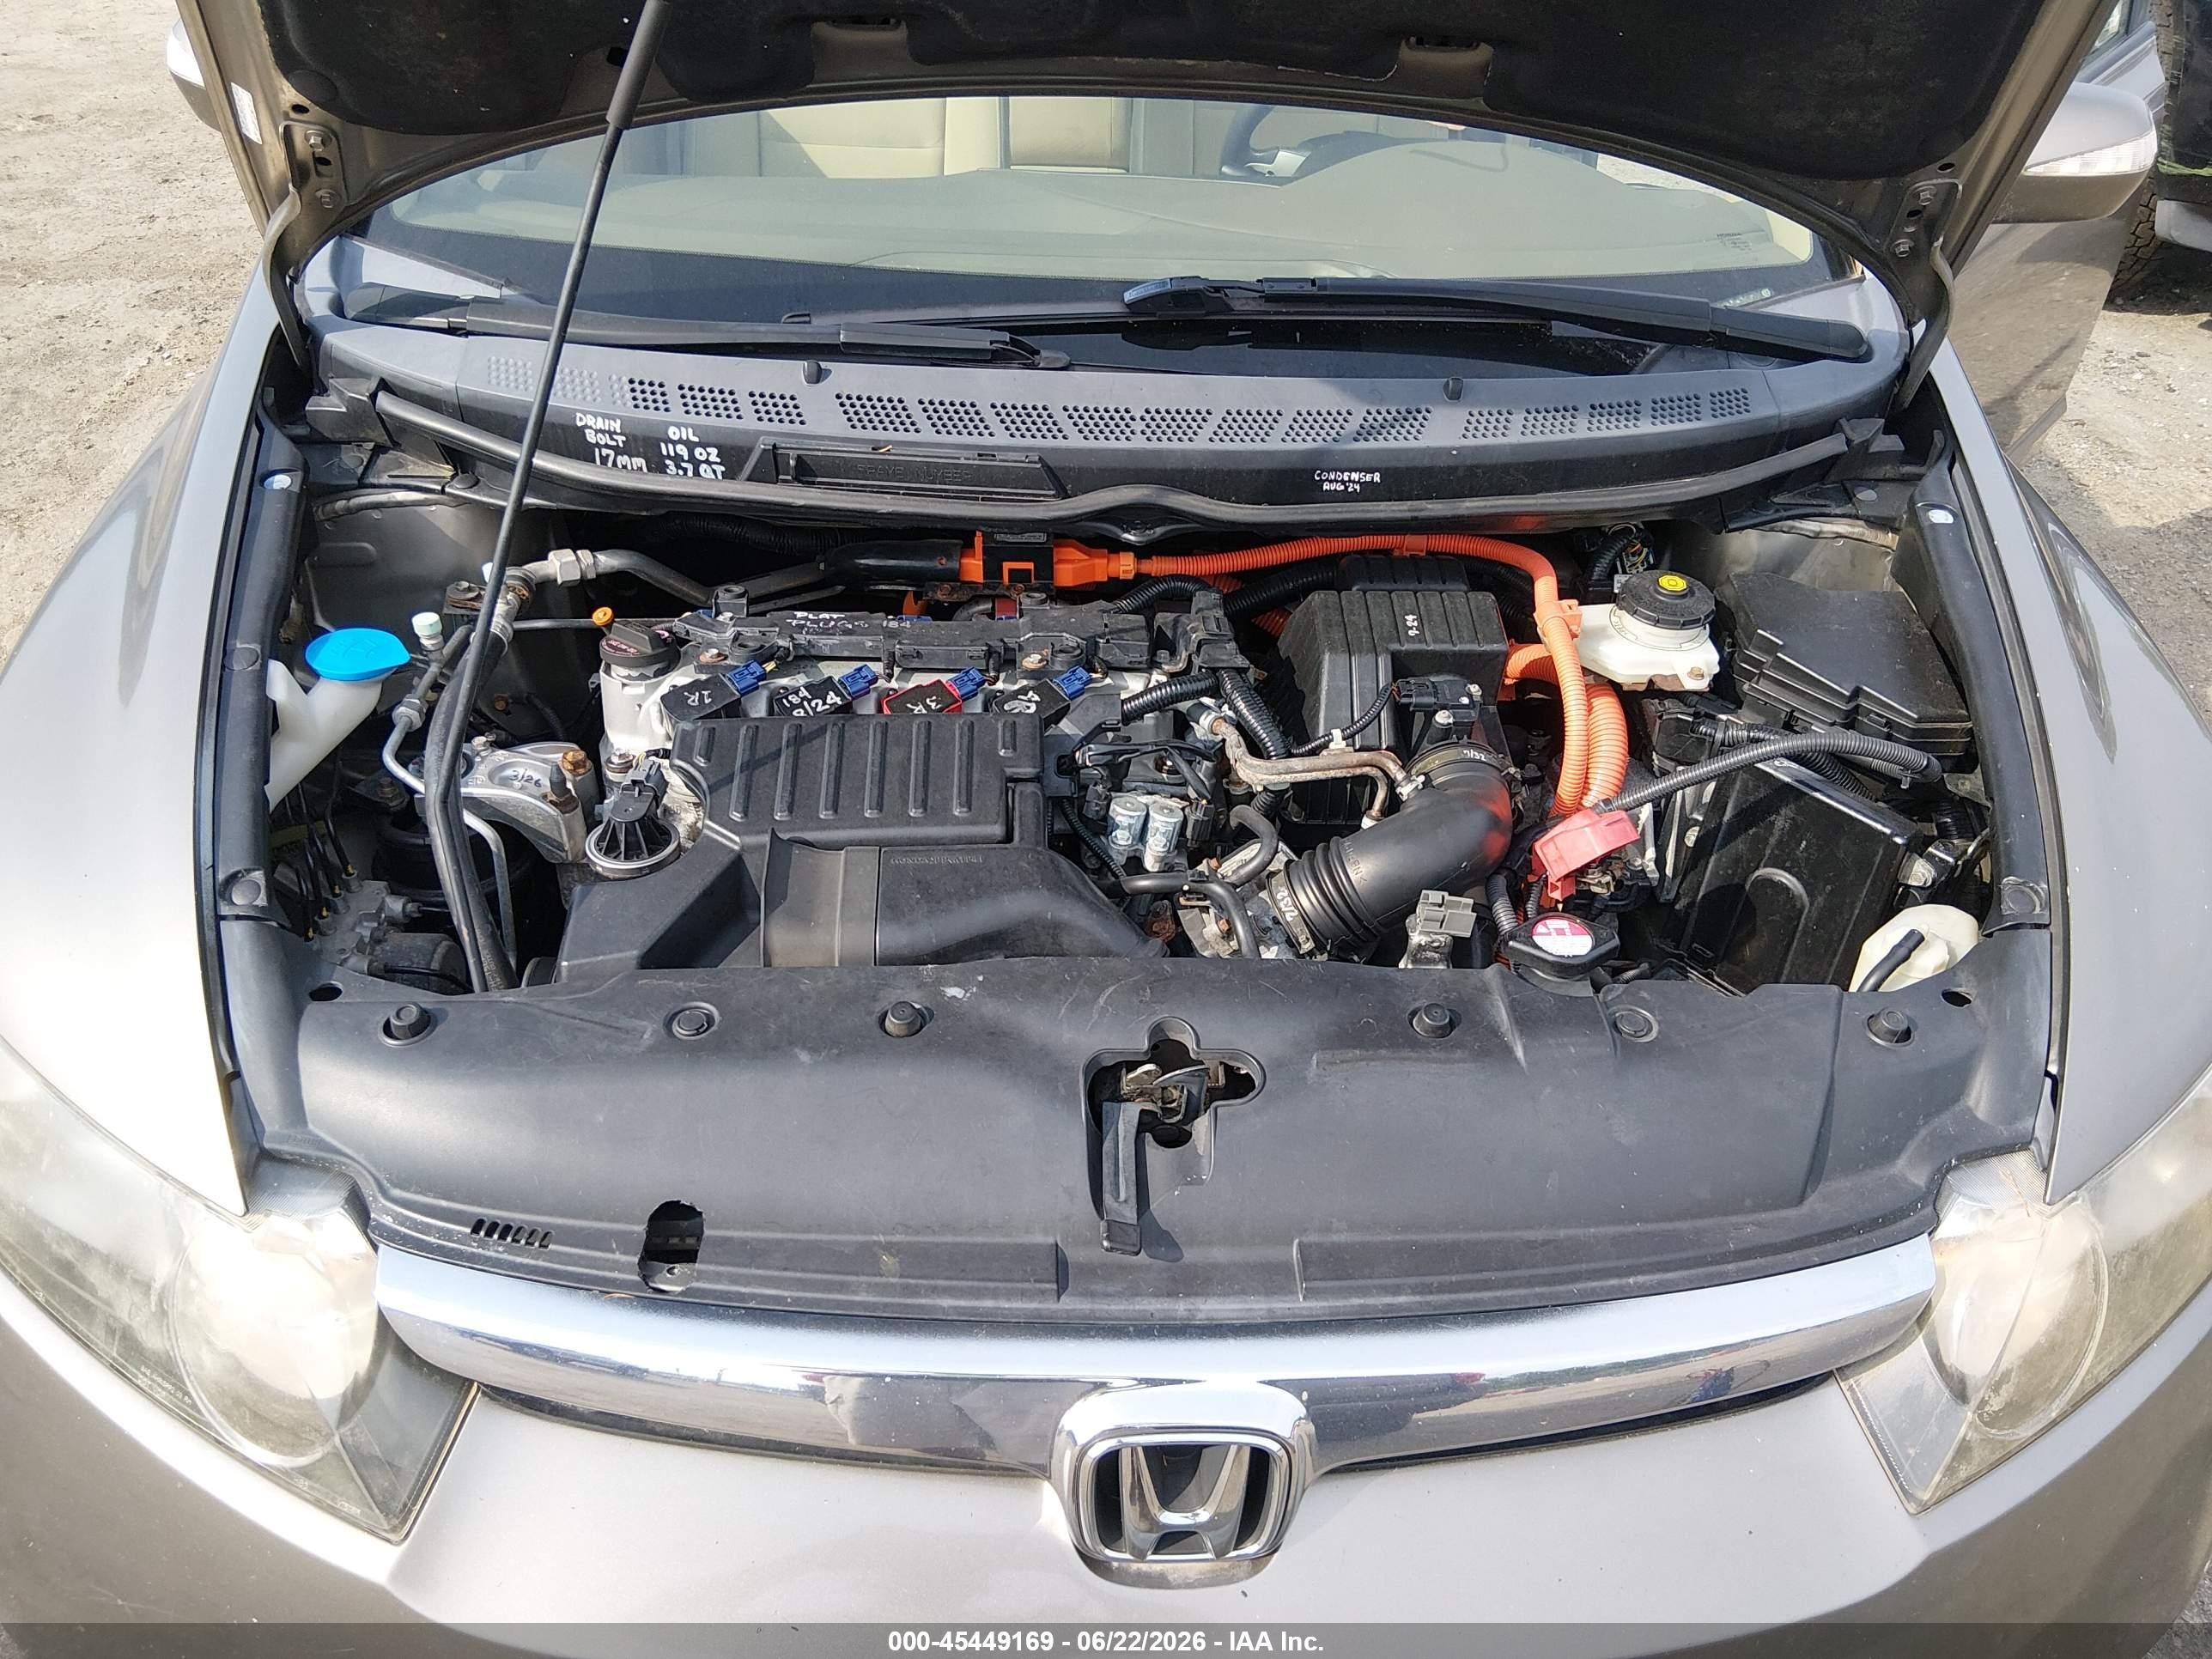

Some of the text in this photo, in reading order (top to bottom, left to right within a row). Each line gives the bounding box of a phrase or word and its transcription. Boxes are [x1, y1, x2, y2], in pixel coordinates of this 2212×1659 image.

[576, 412, 622, 433] DRAIN
[584, 429, 627, 447] BOLT
[667, 426, 701, 442] OIL
[659, 442, 722, 462] 119 OZ
[665, 459, 726, 480] 3.7 QT
[858, 464, 972, 483] FRAME NUMBER
[1314, 470, 1382, 483] CONDENSER
[1322, 482, 1361, 493] AUG '24
[1405, 614, 1420, 636] 9-24
[782, 687, 812, 708] 184
[508, 768, 543, 788] 3/26
